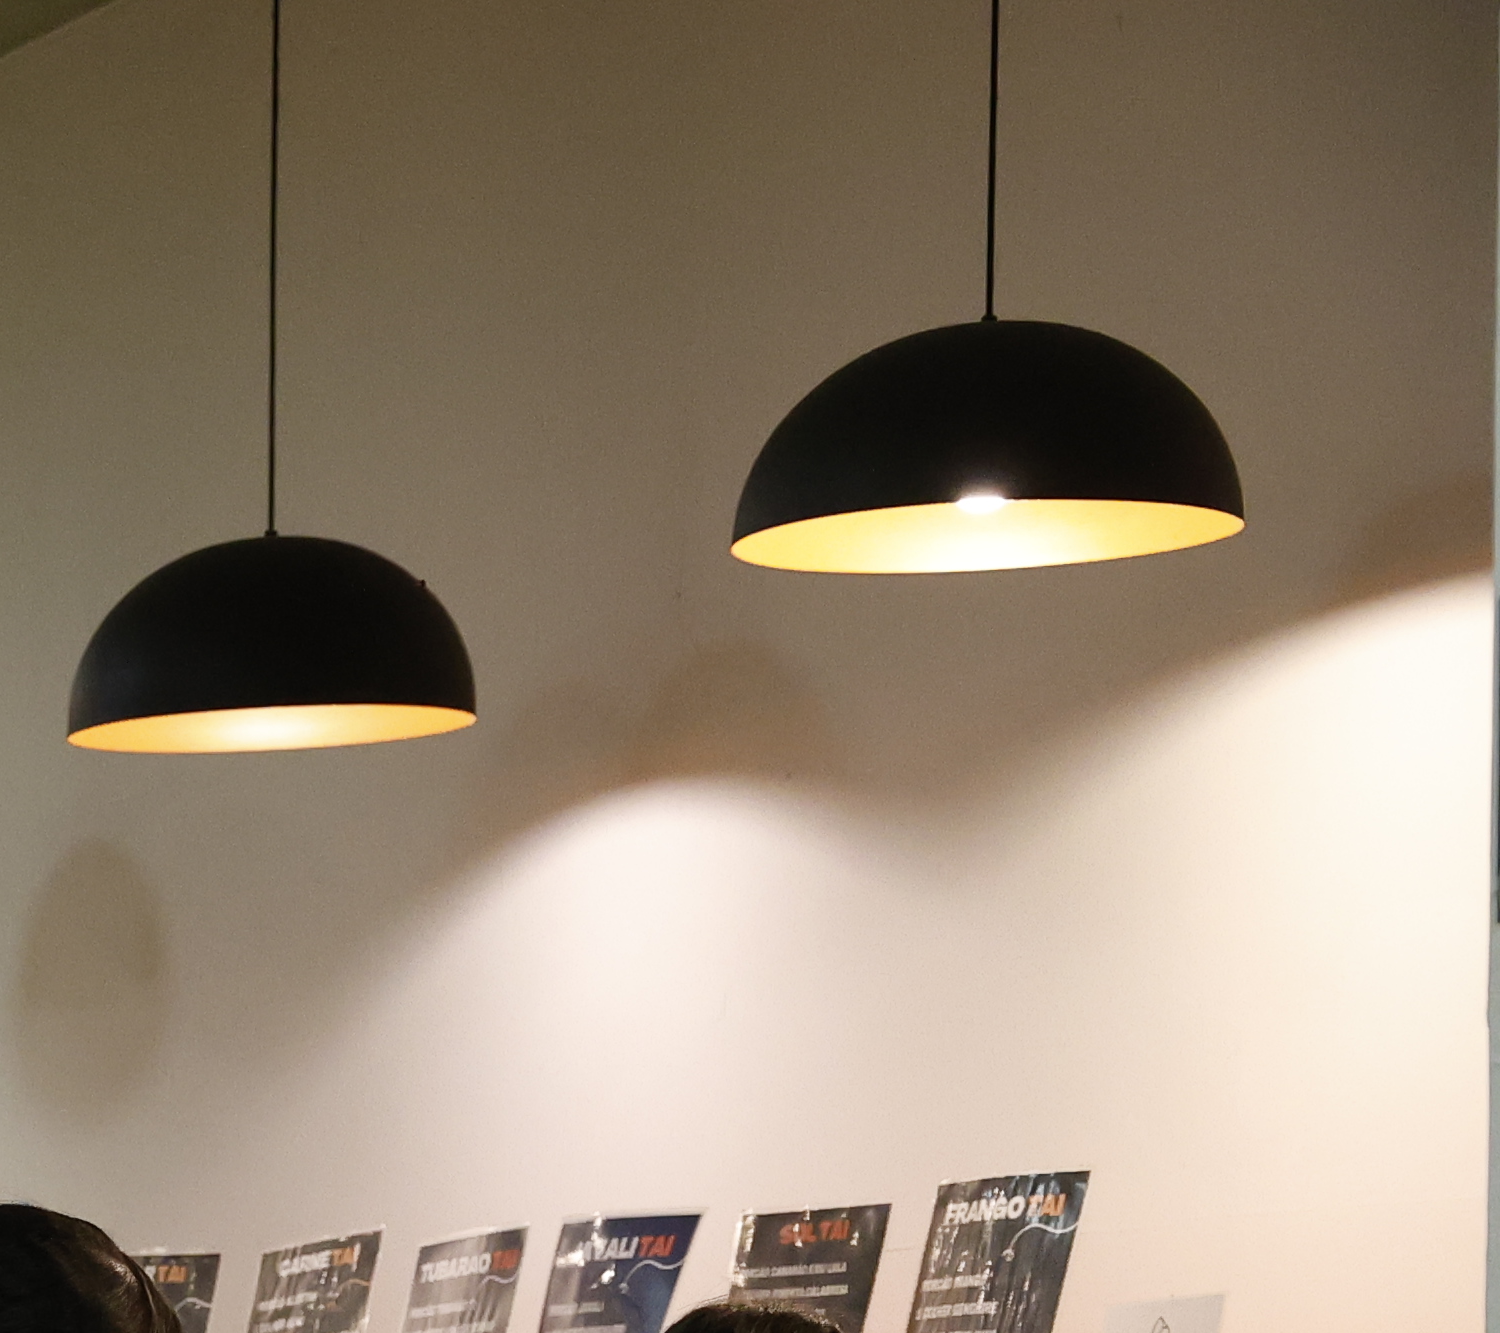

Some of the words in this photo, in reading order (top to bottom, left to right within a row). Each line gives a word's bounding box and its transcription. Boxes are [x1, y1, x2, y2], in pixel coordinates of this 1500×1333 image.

[945, 1195, 1027, 1226] FRANGO
[1027, 1193, 1067, 1218] TAI
[819, 1219, 851, 1241] TAI
[577, 1236, 640, 1261] AVALI
[638, 1235, 676, 1257] TAI
[156, 1264, 187, 1283] TAI
